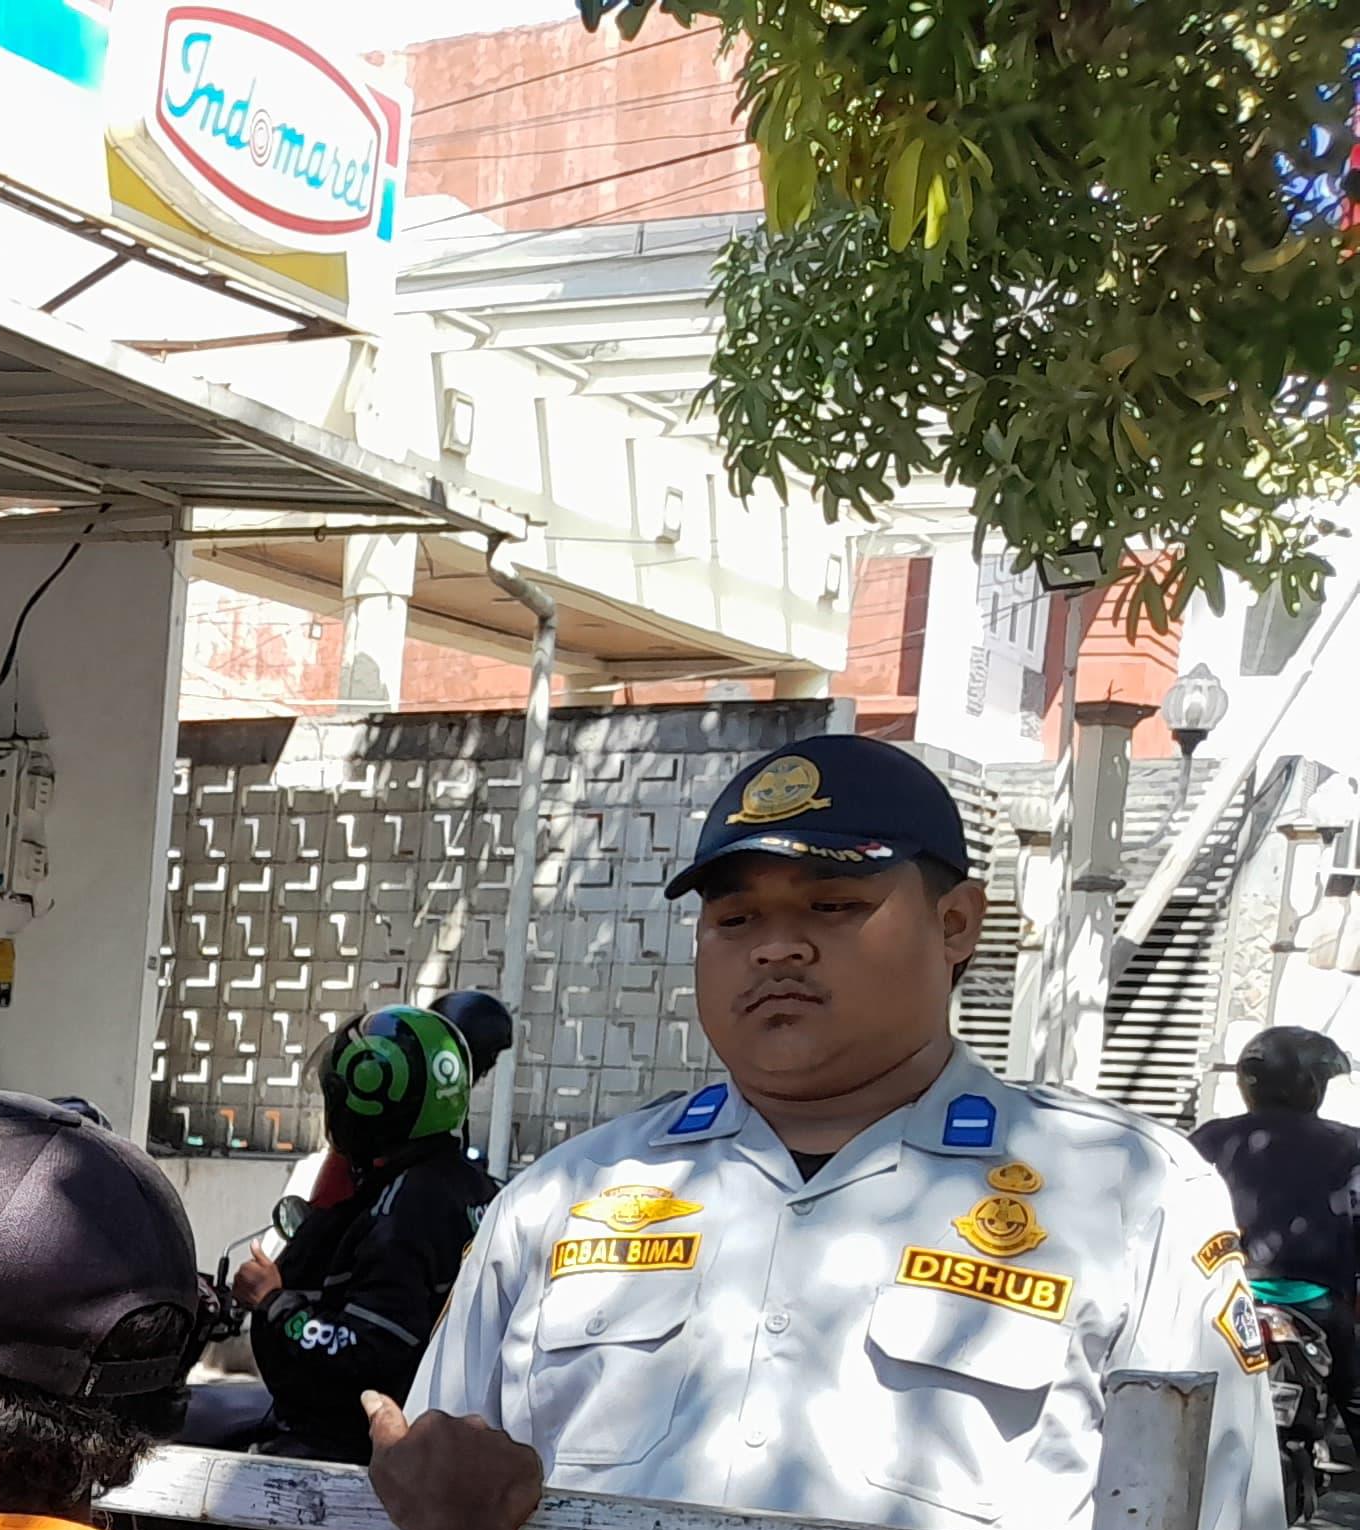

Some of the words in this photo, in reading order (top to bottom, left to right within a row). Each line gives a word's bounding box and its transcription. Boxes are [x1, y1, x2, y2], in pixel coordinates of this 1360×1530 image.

[165, 32, 372, 212] Indomaret
[625, 1239, 685, 1264] BIMA
[910, 1254, 1057, 1309] DISHUB
